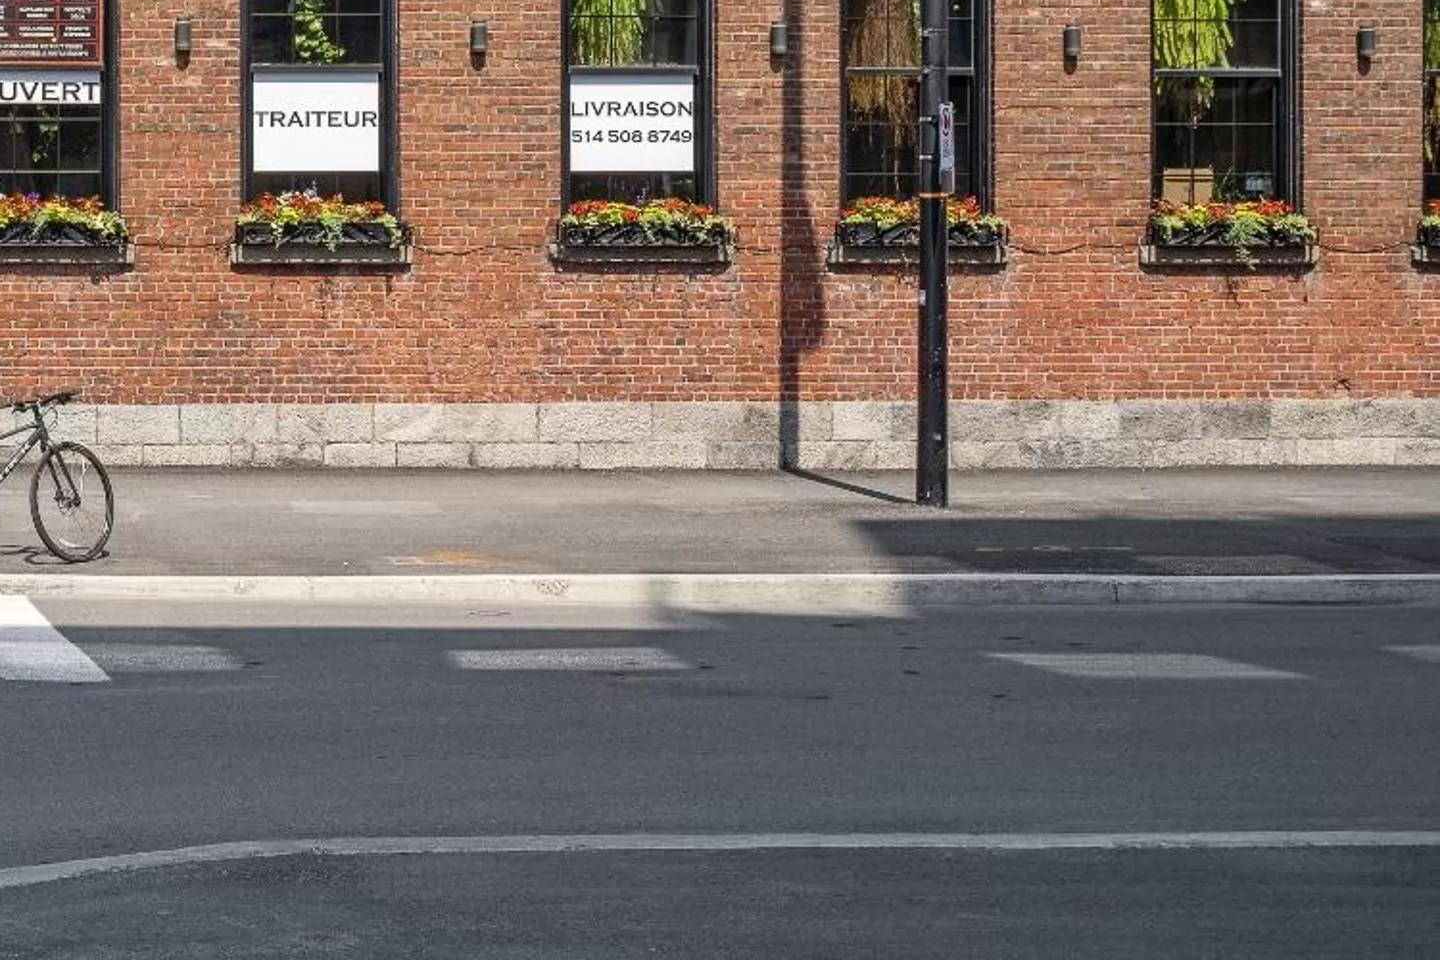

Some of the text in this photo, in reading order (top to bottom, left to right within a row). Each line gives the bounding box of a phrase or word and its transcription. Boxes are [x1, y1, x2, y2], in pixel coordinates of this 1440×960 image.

[571, 101, 693, 117] LIVRAISON
[254, 111, 378, 128] TRAITEUR
[571, 130, 692, 143] 514 508 8749
